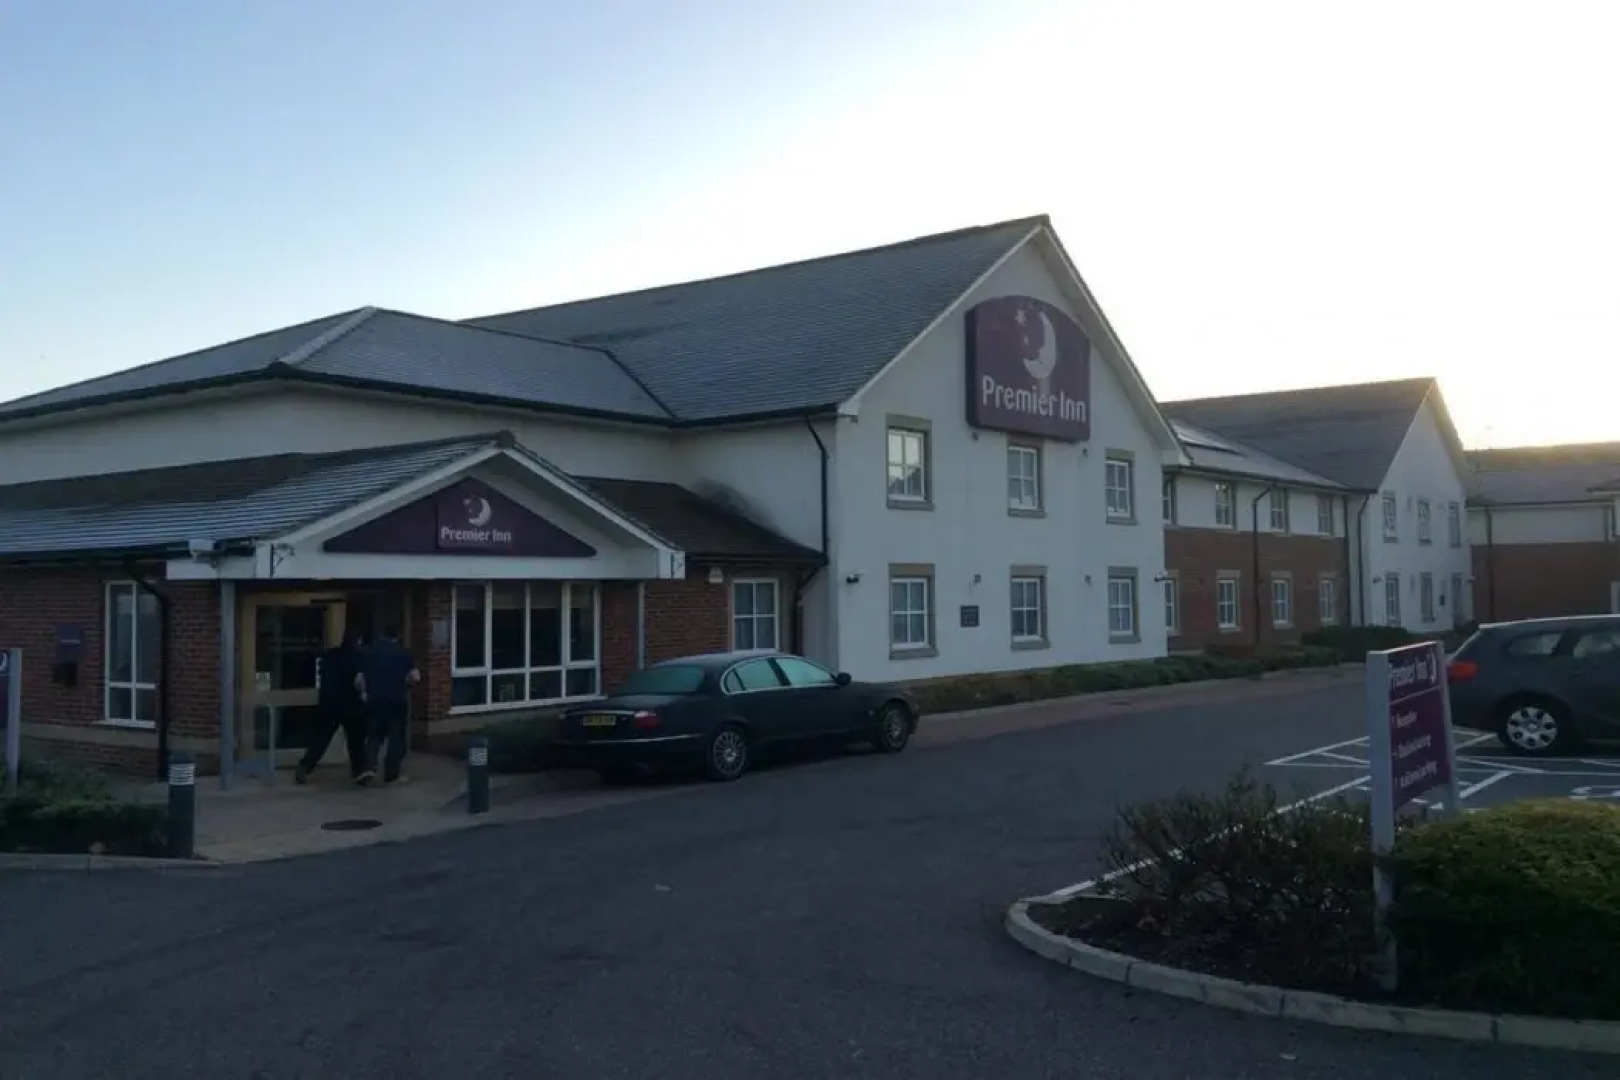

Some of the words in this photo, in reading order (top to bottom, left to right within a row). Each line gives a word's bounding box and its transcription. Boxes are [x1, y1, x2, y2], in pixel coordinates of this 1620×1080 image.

[982, 375, 1057, 417] Premier
[1060, 389, 1086, 423] Inn
[441, 526, 490, 541] Premier
[492, 528, 512, 543] Inn
